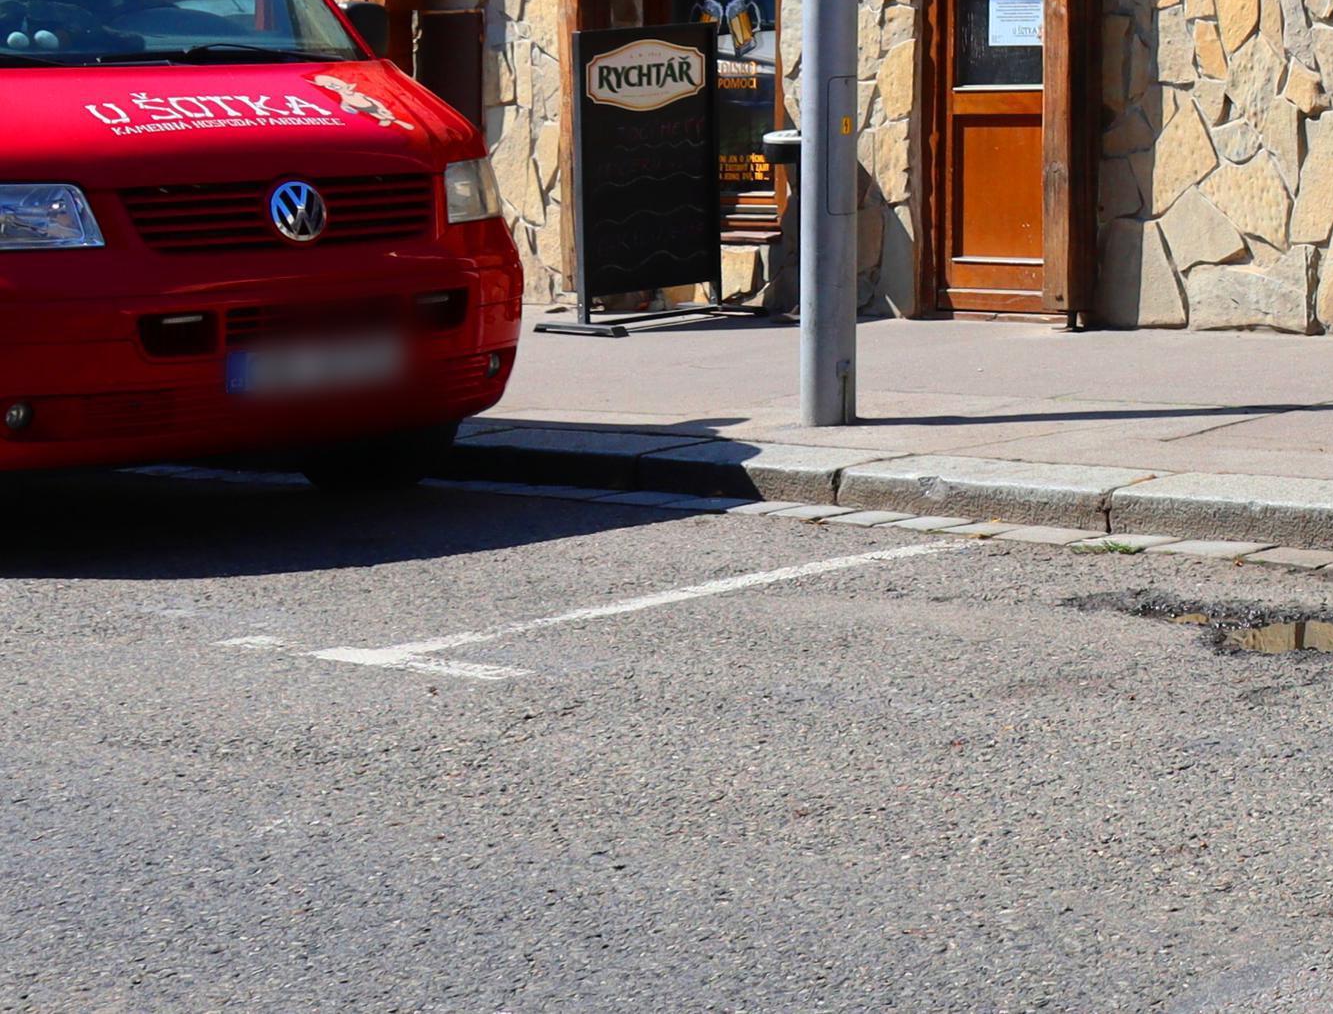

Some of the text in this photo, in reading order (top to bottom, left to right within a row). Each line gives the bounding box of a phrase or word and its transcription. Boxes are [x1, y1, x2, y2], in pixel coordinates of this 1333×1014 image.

[598, 54, 697, 94] RYCHTÁŘ
[84, 91, 333, 124] U ŠOTKA
